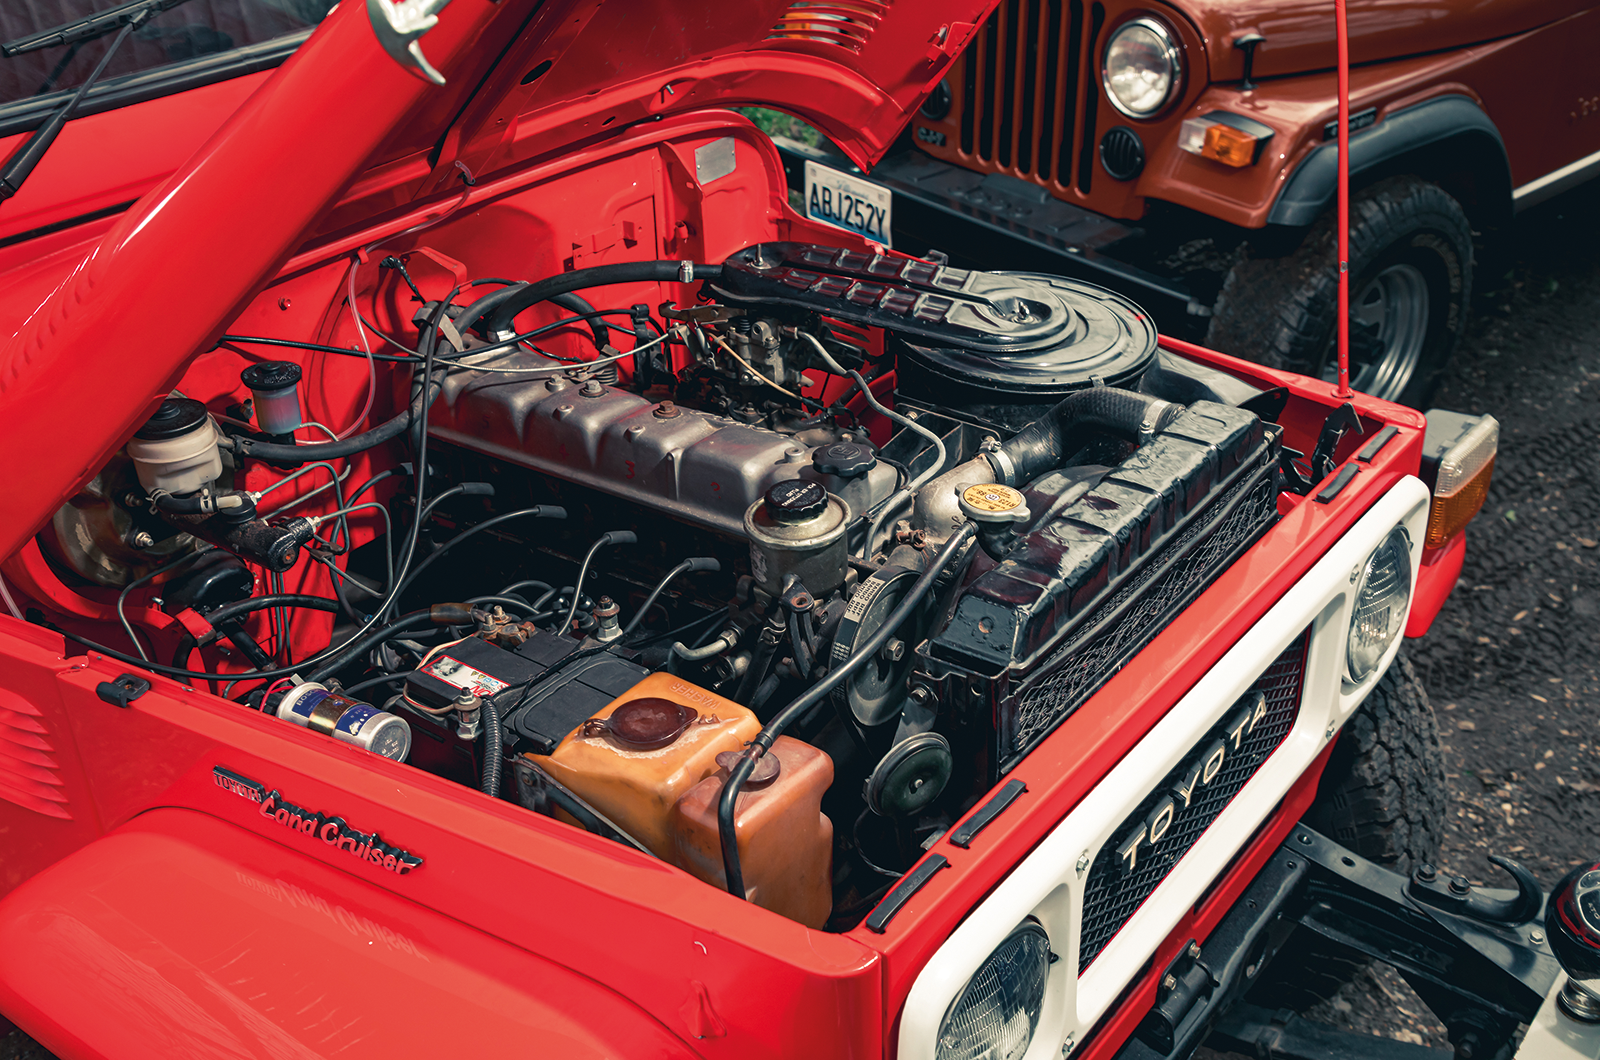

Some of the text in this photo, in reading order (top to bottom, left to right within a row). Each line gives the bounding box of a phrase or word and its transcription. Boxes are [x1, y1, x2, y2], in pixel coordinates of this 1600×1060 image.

[810, 182, 886, 238] ABJ252Y
[623, 460, 635, 479] 3
[669, 681, 722, 710] WASHER
[213, 771, 262, 803] TOYOTA
[1122, 697, 1266, 870] TOYOTA
[259, 791, 423, 875] Land Cruiser
